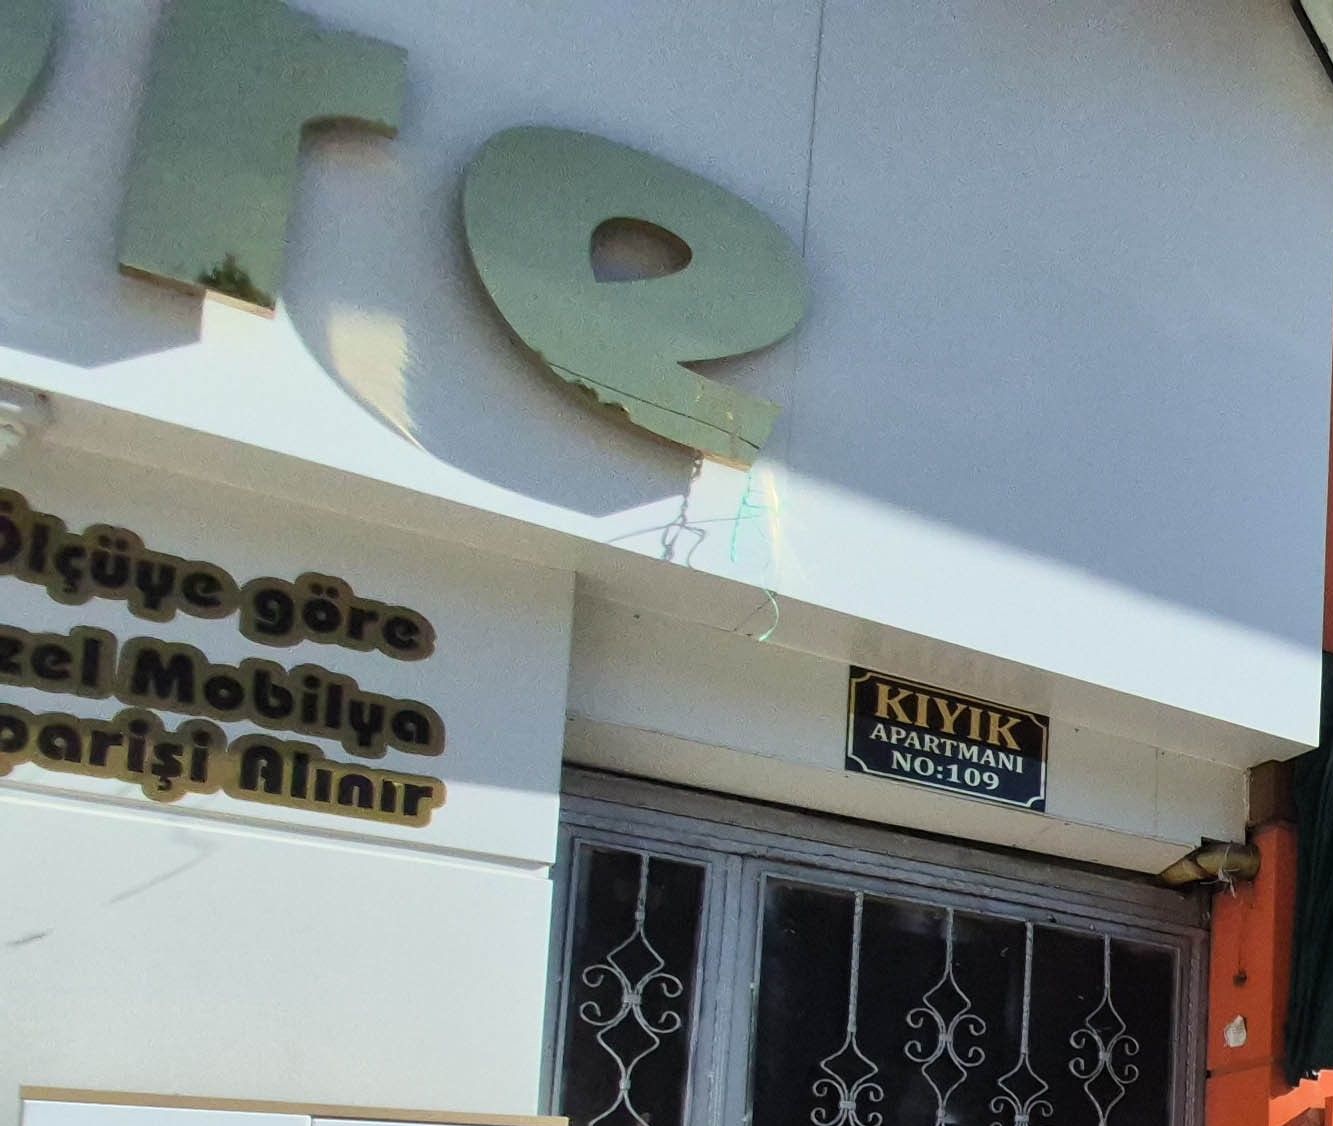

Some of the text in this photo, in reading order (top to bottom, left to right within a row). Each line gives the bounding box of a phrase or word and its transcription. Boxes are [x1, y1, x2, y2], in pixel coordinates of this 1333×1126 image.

[0, 0, 803, 470] re
[252, 583, 421, 651] göre
[131, 649, 430, 747] Mobilya
[874, 682, 1022, 751] KIYIK
[240, 745, 434, 816] Alınır
[869, 722, 1024, 774] APARTMANI
[890, 750, 1000, 791] NO:109
